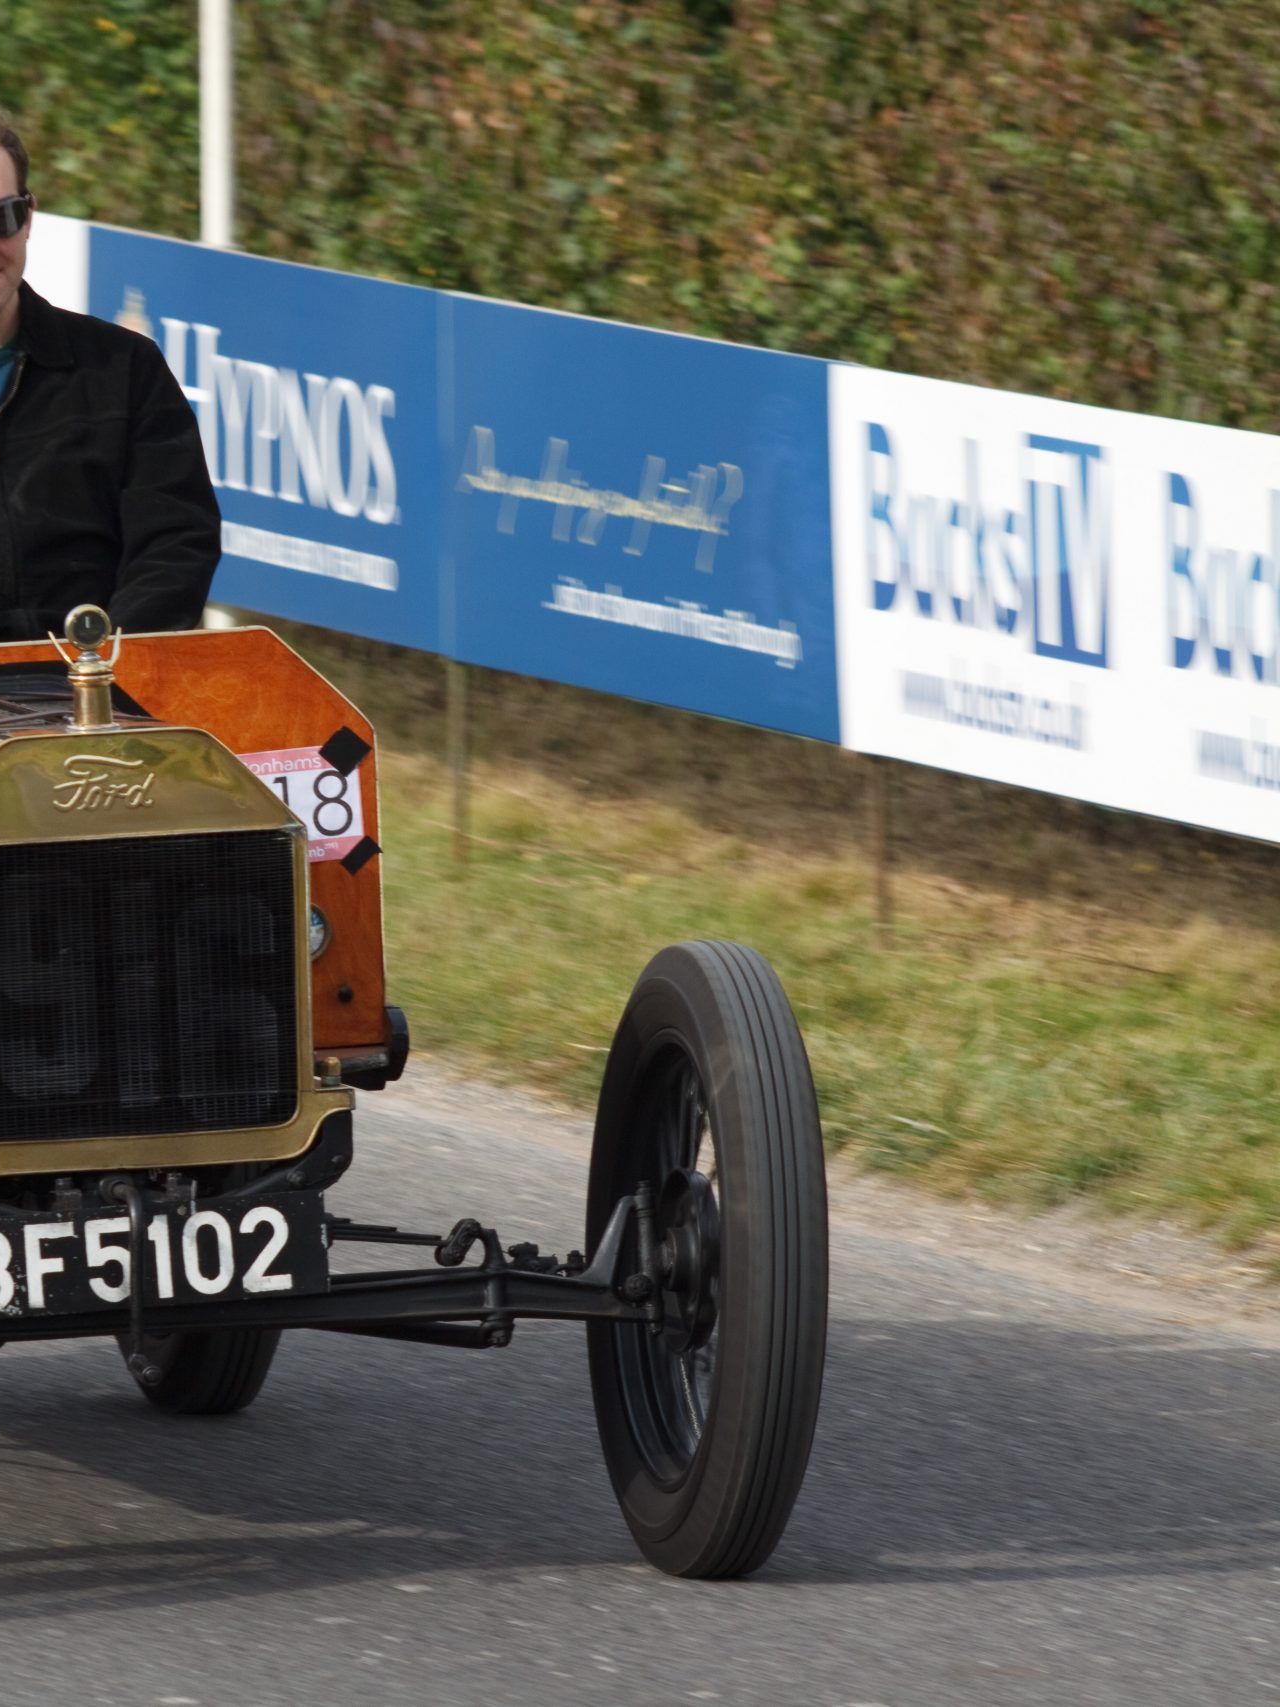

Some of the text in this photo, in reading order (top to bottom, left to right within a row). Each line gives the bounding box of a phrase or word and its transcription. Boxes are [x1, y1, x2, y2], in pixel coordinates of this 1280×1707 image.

[160, 317, 400, 525] HYPNOS
[52, 754, 155, 811] Ford
[244, 757, 322, 773] onhams
